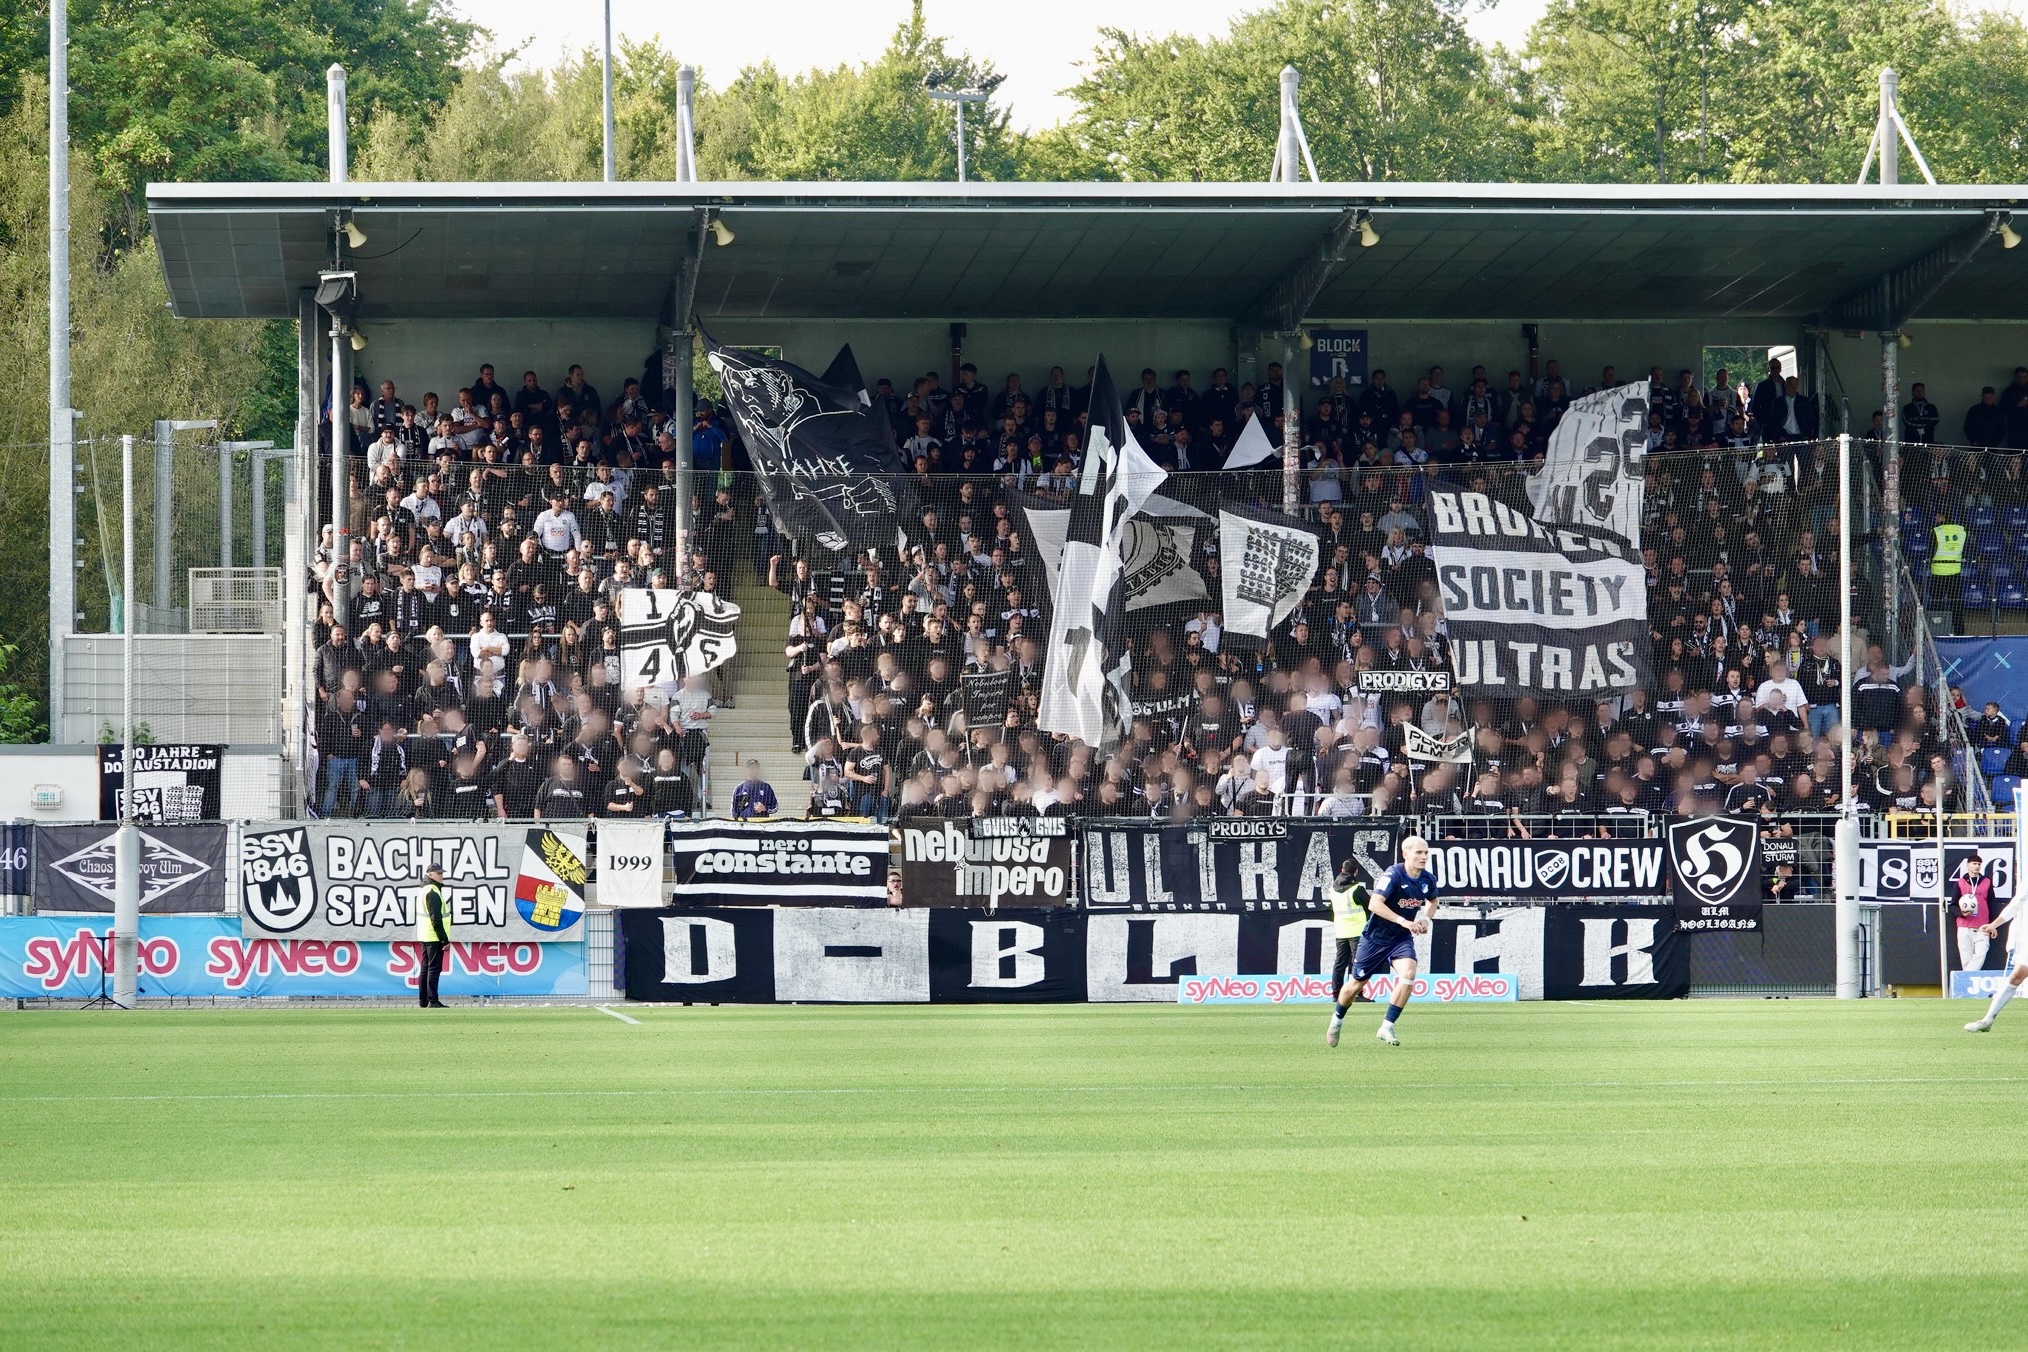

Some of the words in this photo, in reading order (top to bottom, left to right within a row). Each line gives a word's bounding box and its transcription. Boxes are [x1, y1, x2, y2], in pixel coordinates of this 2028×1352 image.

[1318, 339, 1360, 352] BLOCK
[1440, 565, 1627, 616] SOCIETY
[639, 648, 660, 684] 4
[1452, 639, 1637, 690] ULTRAS
[1361, 672, 1447, 689] PRODIGYS
[1409, 731, 1469, 752] POWER
[120, 747, 145, 760] 10
[151, 746, 201, 760] JAHRE
[104, 758, 217, 773] DOAUSTADION
[973, 817, 1019, 837] NOVUS
[1211, 821, 1286, 837] PRODIGYS
[761, 837, 809, 851] nero
[1763, 842, 1794, 851] DONAU
[79, 860, 114, 874] Chaos
[160, 860, 182, 874] Ulm
[327, 836, 510, 880] BACHTAL
[609, 855, 652, 871] 1999
[694, 851, 871, 875] constante
[1087, 829, 1391, 904] ULTRAS
[1428, 846, 1533, 888] DONAU
[1572, 846, 1664, 888] CREW
[1764, 853, 1795, 862] STURM
[1916, 859, 1938, 867] SSV
[243, 854, 309, 882] 1846
[954, 857, 1064, 908] impero
[326, 885, 507, 927] SPATEN
[1245, 901, 1331, 912] SOCIET
[1701, 907, 1729, 917] ULM
[26, 931, 176, 987] syNo
[208, 938, 359, 987] syNeo
[1185, 978, 1258, 1002] syNeo
[1434, 977, 1507, 1001] syNeo
